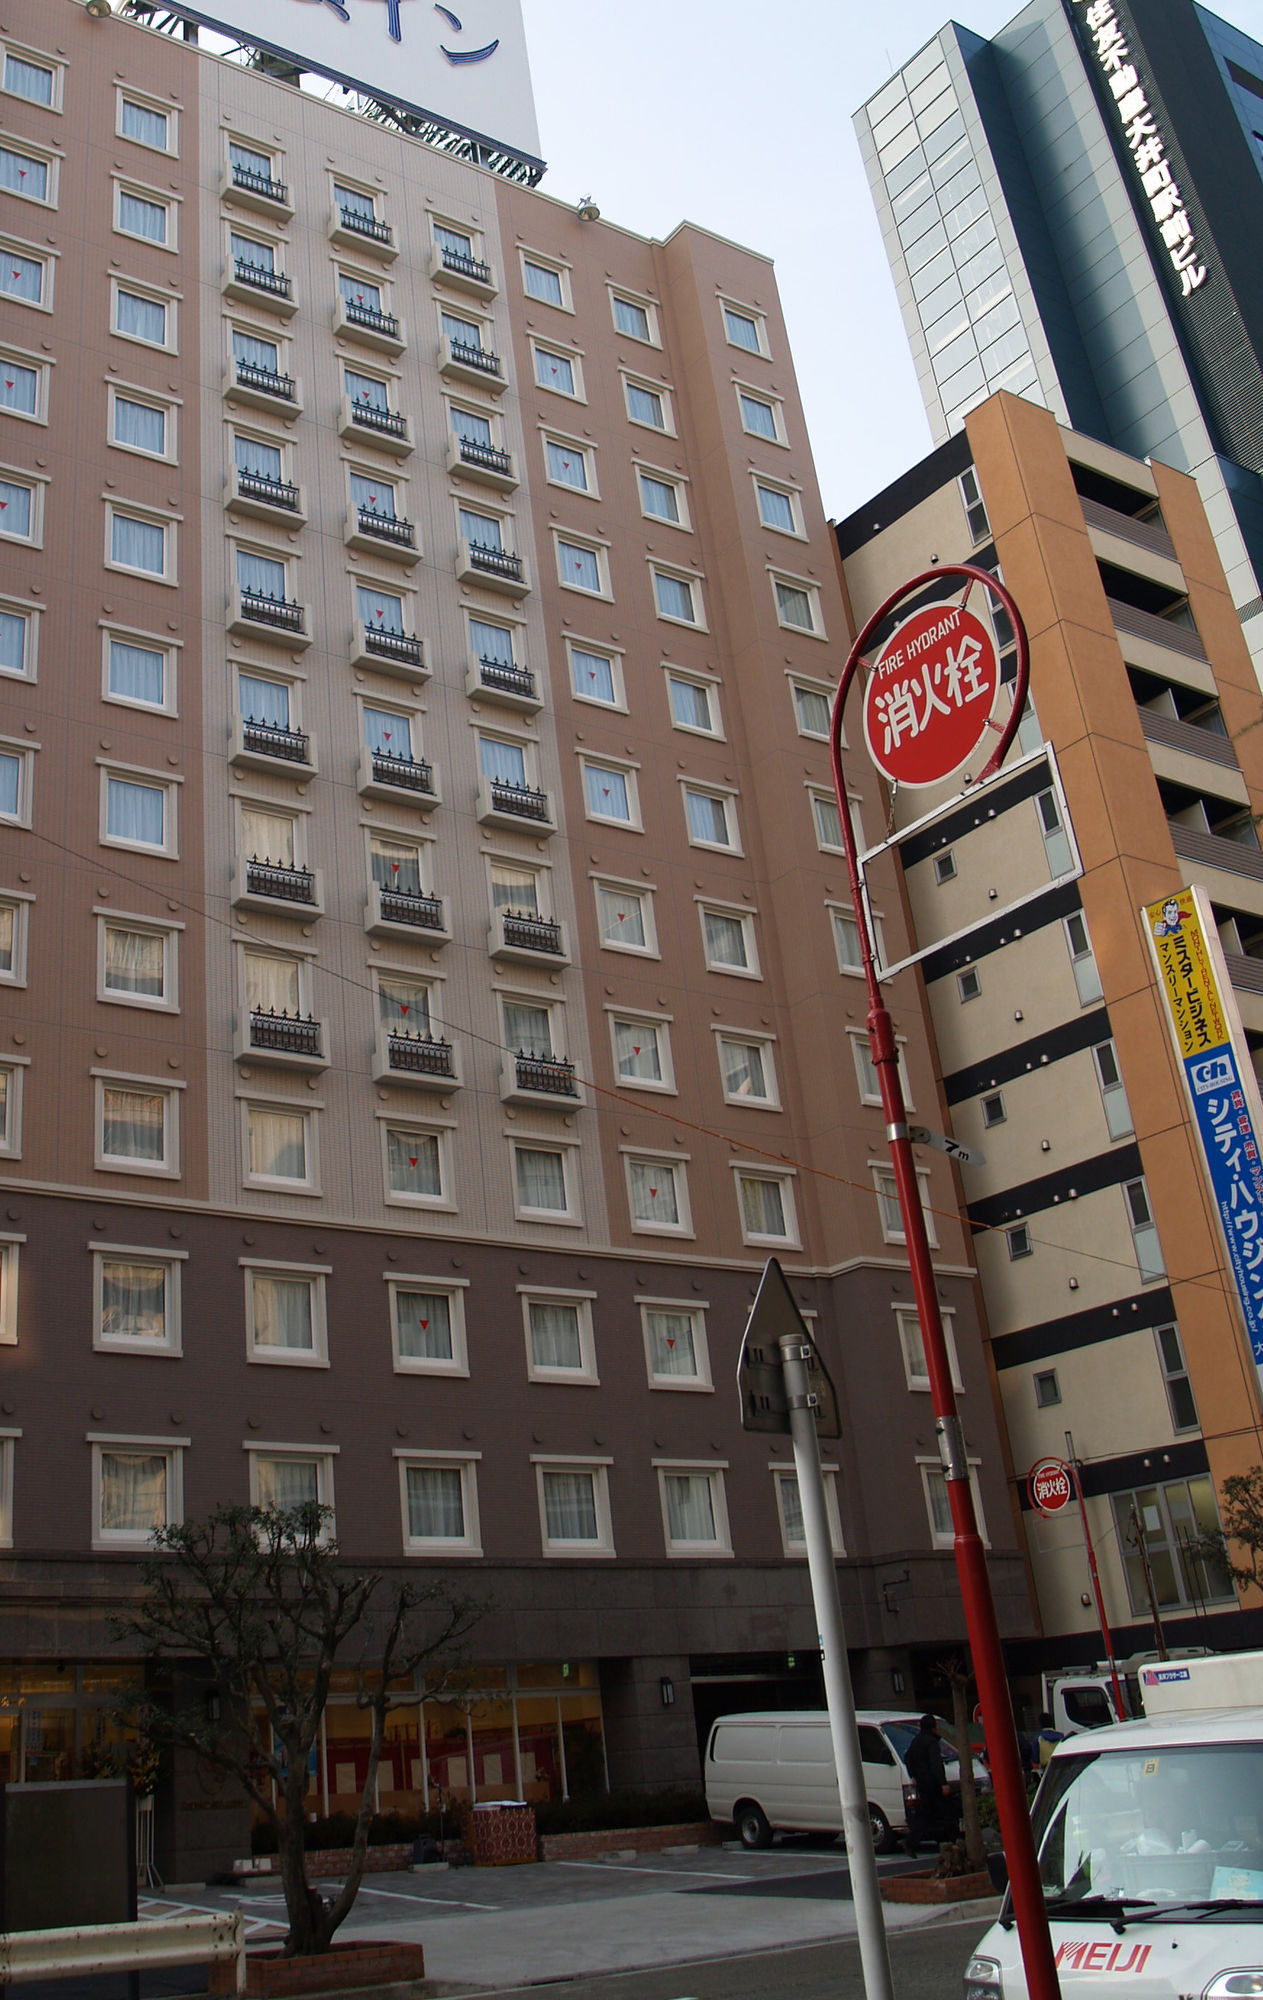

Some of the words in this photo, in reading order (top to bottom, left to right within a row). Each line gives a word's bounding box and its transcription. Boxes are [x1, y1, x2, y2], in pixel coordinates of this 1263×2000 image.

[878, 650, 905, 680] FIRE
[906, 610, 961, 661] HYDRANT
[875, 635, 989, 755] 消火栓
[1160, 942, 1194, 1053] マンスリーマンション
[1173, 935, 1212, 1048] ミスタービジネス
[1037, 1477, 1067, 1500] 消火栓
[1055, 1941, 1152, 1973] MEIJI
